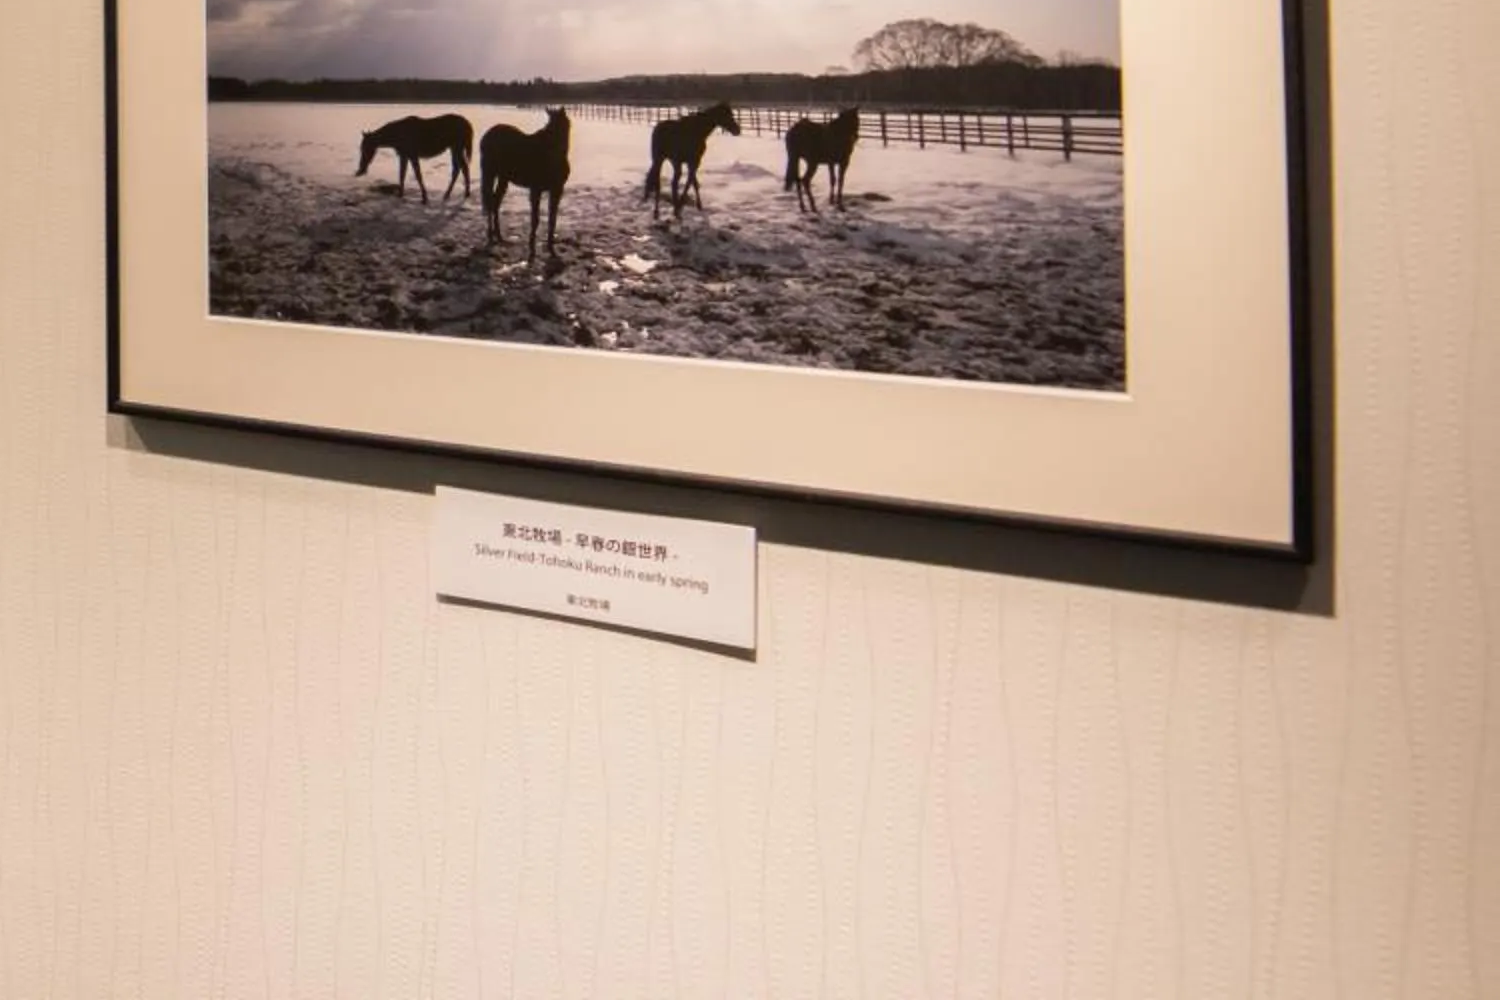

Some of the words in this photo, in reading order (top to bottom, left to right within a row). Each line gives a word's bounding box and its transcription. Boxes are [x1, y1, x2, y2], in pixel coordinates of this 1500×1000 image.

[474, 542, 505, 558] Silver
[585, 559, 621, 578] Ranch
[623, 566, 636, 580] in
[638, 570, 667, 587] early
[670, 575, 709, 595] spring
